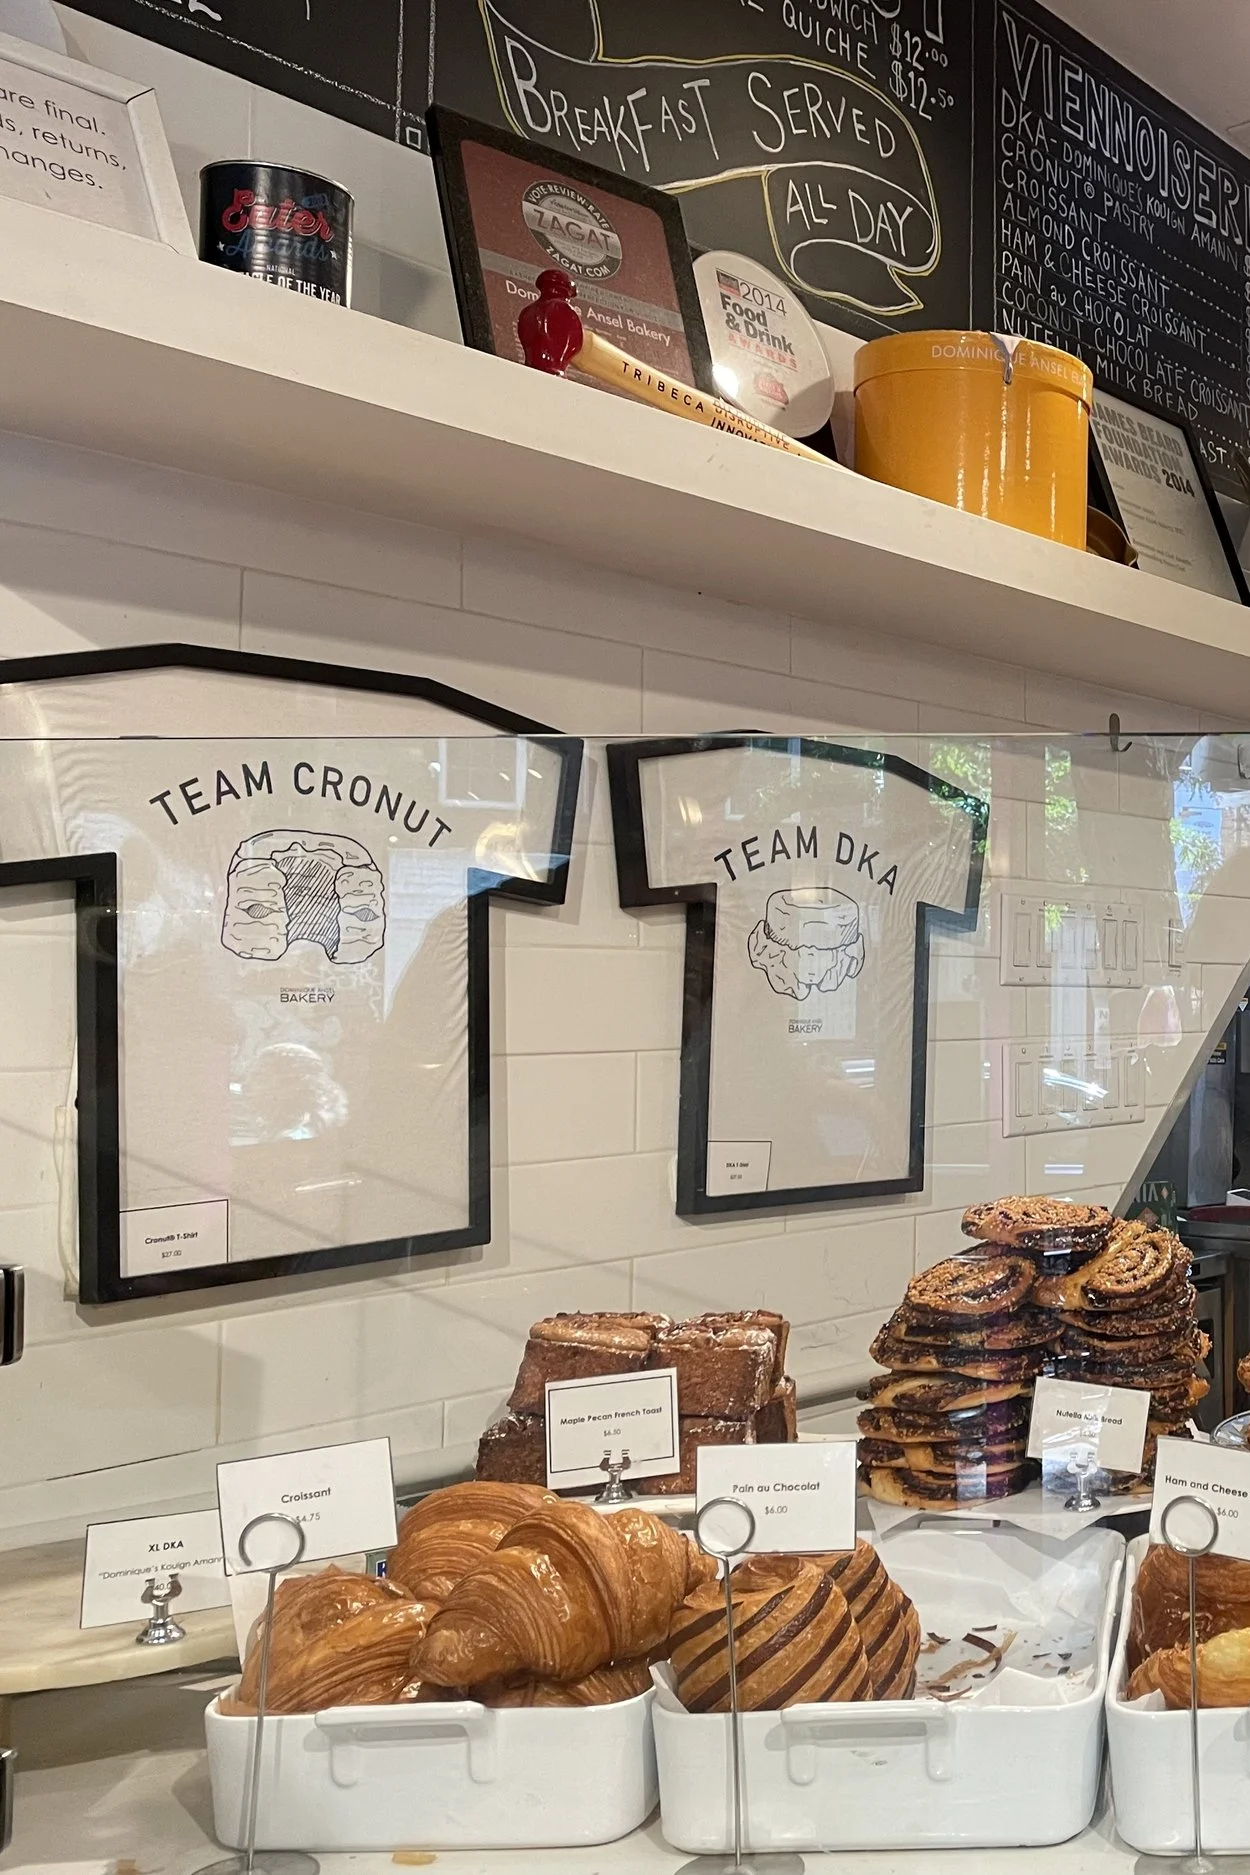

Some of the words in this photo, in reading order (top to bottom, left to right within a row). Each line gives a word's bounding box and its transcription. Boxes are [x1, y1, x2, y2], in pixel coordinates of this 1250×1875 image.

[782, 0, 876, 79] QUICHE
[44, 99, 106, 136] final.
[503, 35, 720, 173] BREAKFAST
[746, 71, 896, 160] SERVED
[32, 126, 127, 171] returns,
[221, 188, 335, 243] Eater
[785, 179, 838, 226] ALL
[849, 189, 915, 258] DAY
[1001, 159, 1108, 243] CROISSANT
[1063, 141, 1144, 212] DOMINIQUE'S
[1146, 193, 1186, 236] KOUIGN
[1190, 223, 1239, 272] AMANN
[1103, 190, 1155, 245] PASTRY
[225, 228, 328, 262] Awards
[532, 208, 612, 251] ZAGAT
[1002, 191, 1075, 250] ALMOND
[1081, 236, 1171, 309] CROISSANT
[545, 247, 611, 278] ZAGAT.COM
[740, 282, 788, 317] 2014
[1001, 218, 1038, 263] HAM
[1043, 244, 1056, 272] &
[1059, 251, 1127, 306] CHEESE
[1131, 293, 1207, 355] CROISSANT
[1002, 250, 1043, 295] PAIN
[1072, 289, 1153, 349] CHOCOLAT
[586, 307, 624, 329] Ansel
[627, 318, 671, 347] Bakery
[720, 292, 768, 328] Food
[725, 312, 741, 333] &
[744, 320, 796, 356] Drink
[1002, 281, 1084, 340] COCONUT
[1094, 327, 1186, 394] CHOCOLATE
[621, 361, 705, 414] TRIBECA
[1030, 354, 1068, 380] ANSEL
[1095, 354, 1137, 393] MILK
[1143, 379, 1199, 422] BREAD
[1092, 400, 1137, 439] JAMES
[1137, 420, 1184, 458] BEARD
[1092, 418, 1185, 477] FOUNDATION
[1101, 441, 1162, 486] AWARDS
[1162, 467, 1195, 499] 2014
[150, 760, 273, 826] TEAM
[293, 761, 453, 848] CRONUT
[713, 825, 818, 883] TEAM
[835, 831, 899, 896] DKA
[279, 993, 336, 1004] BAKERY
[788, 1023, 824, 1034] BAKERY
[560, 1417, 586, 1426] Maple
[587, 1413, 613, 1423] Pecan
[614, 1409, 641, 1419] French
[642, 1406, 663, 1416] Toast
[1055, 1409, 1083, 1420] Nutella
[1101, 1415, 1124, 1426] Bread
[280, 1486, 332, 1504] Croissant
[732, 1482, 755, 1494] Pain
[757, 1484, 771, 1493] au
[772, 1480, 821, 1493] Chocolat
[1165, 1474, 1188, 1488] Ham
[1189, 1480, 1209, 1492] and
[1211, 1482, 1249, 1499] Cheese
[764, 1505, 789, 1516] $6.00
[1216, 1507, 1240, 1520] $6.00
[148, 1543, 161, 1553] XL
[163, 1540, 185, 1551] DKA
[160, 1560, 192, 1572] Kouign
